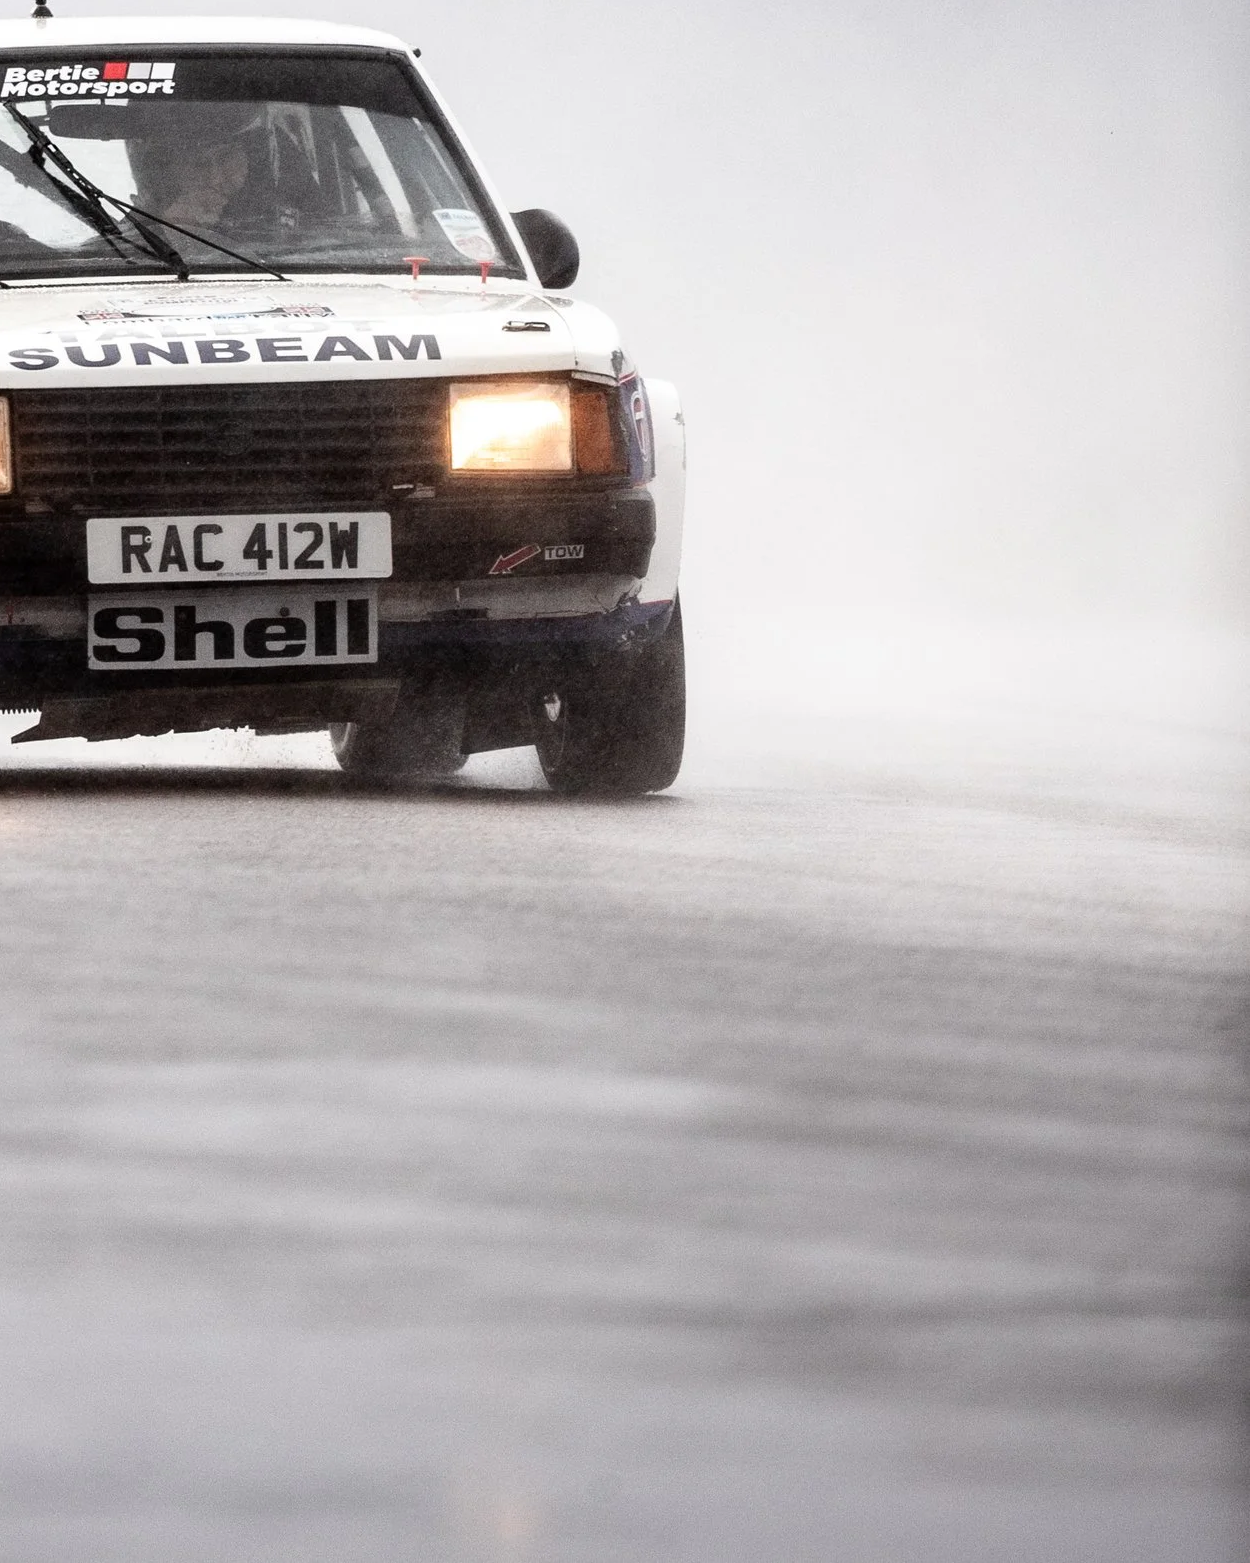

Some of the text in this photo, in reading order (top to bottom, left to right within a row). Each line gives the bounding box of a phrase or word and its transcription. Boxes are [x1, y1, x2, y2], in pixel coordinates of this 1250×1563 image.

[4, 64, 100, 83] Bertie
[0, 78, 176, 98] Motorsport
[45, 319, 385, 343] TALBOT
[8, 334, 442, 371] SUNBEAM
[121, 521, 359, 574] RAC 412W
[545, 545, 583, 559] TOW
[92, 598, 370, 663] Shell
